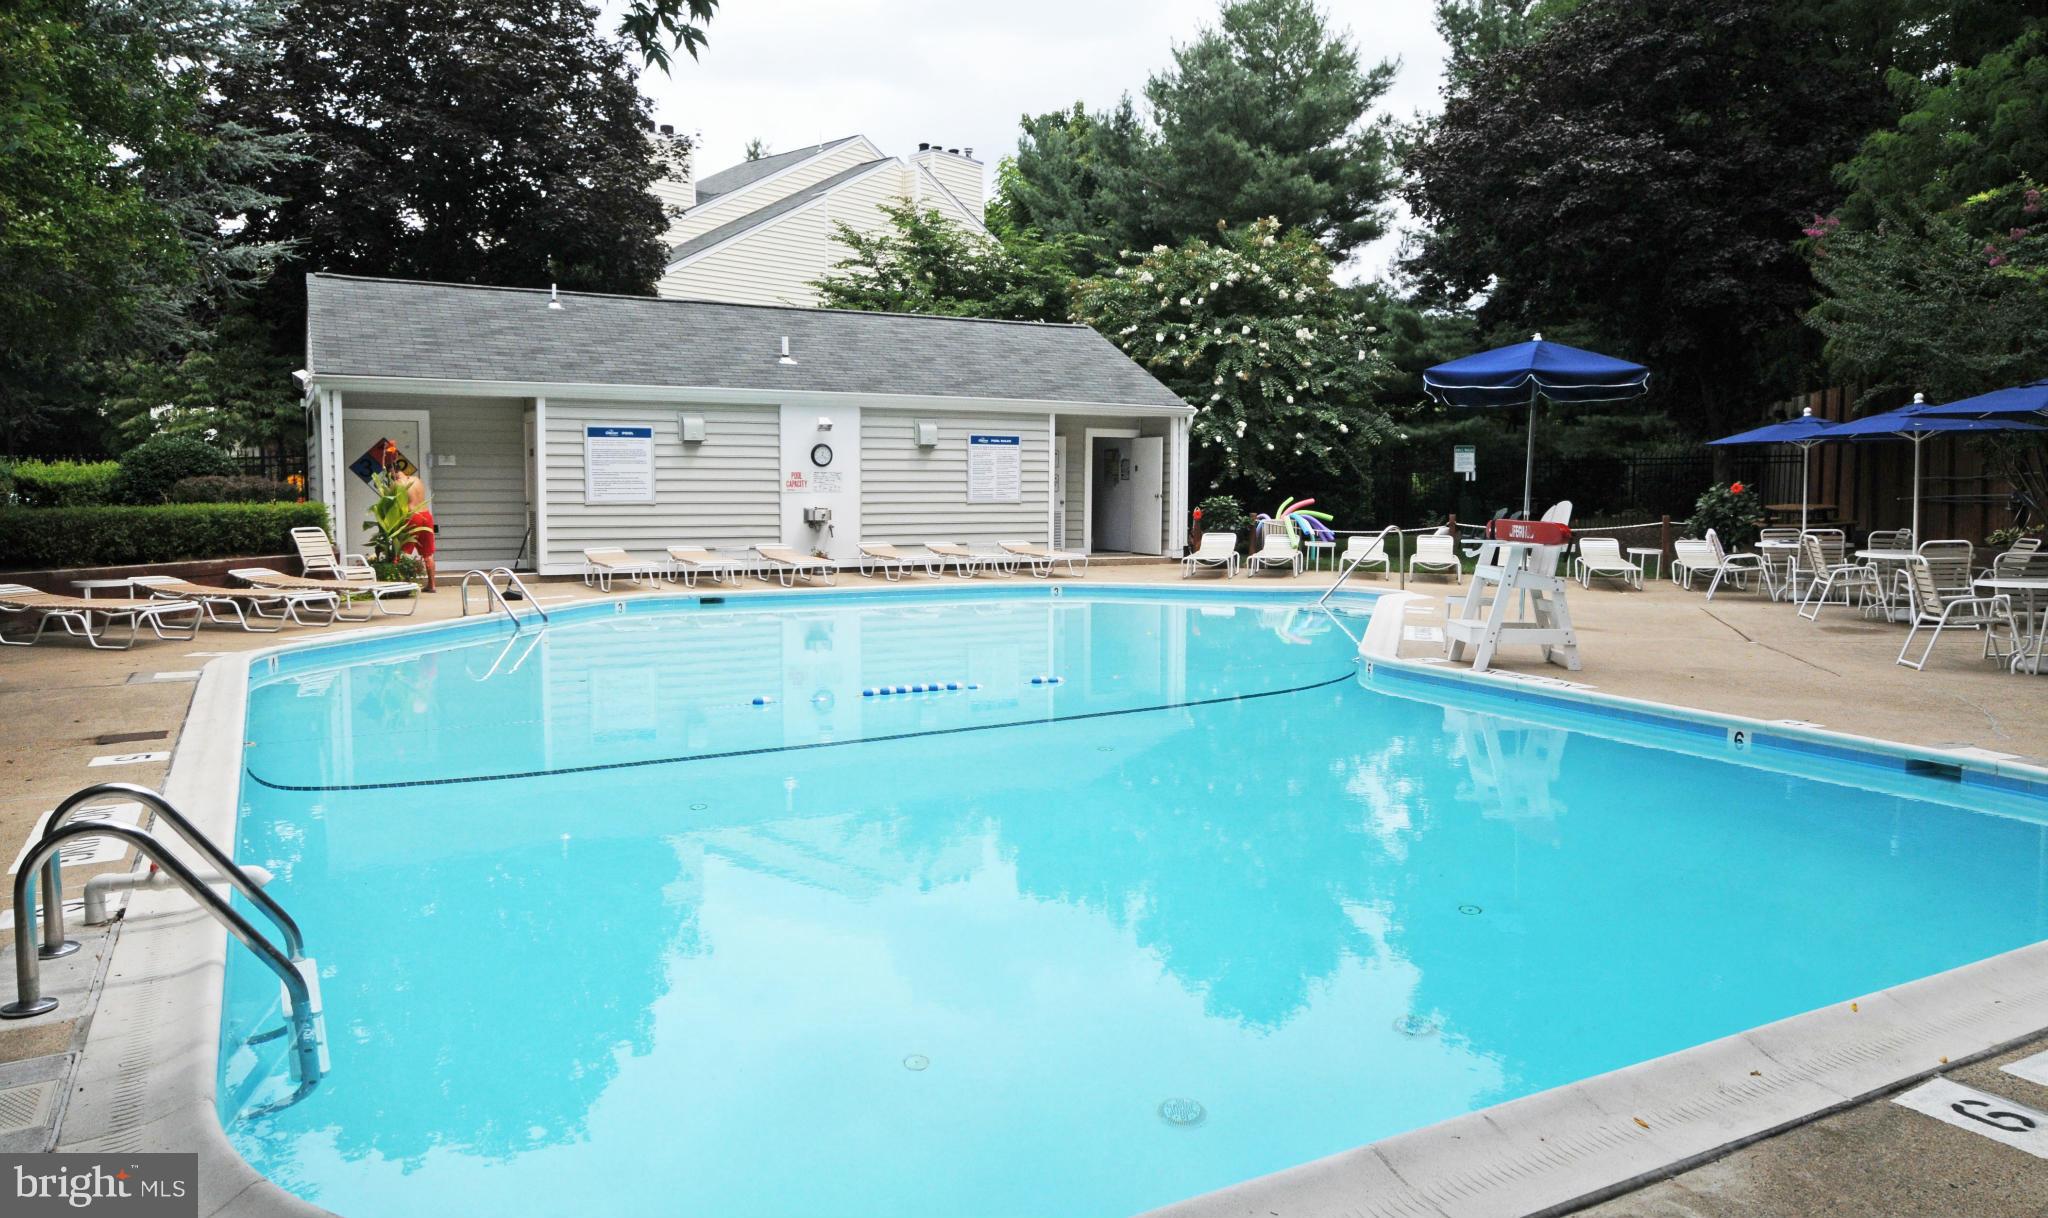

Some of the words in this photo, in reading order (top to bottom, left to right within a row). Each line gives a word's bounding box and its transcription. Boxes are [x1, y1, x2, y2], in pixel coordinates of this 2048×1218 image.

[786, 480, 808, 488] CAPACITY
[1734, 731, 1745, 750] 6
[1951, 1099, 2036, 1132] 6
